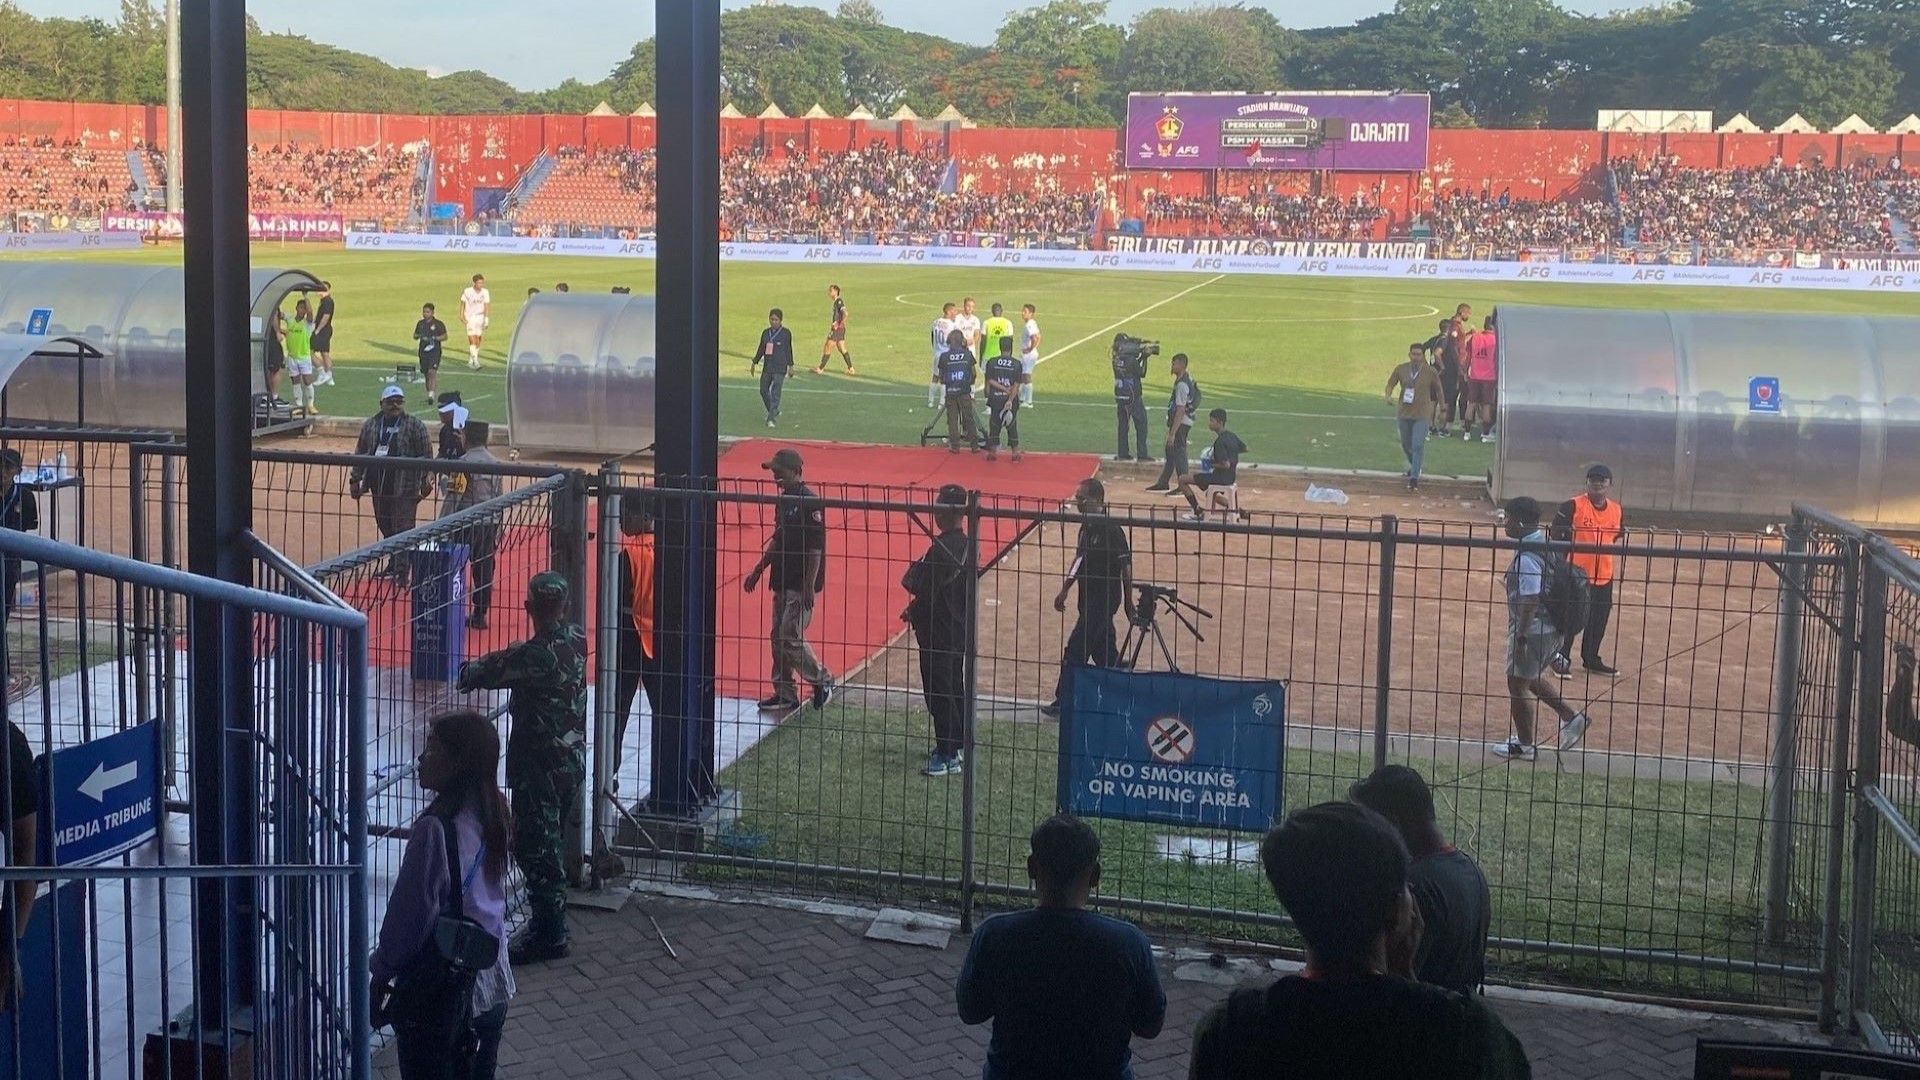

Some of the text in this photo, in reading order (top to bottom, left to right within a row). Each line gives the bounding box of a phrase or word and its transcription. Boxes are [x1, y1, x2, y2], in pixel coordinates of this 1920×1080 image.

[1237, 102, 1309, 116] STADION BRAWIJAYA
[1350, 122, 1410, 143] DJAJATI
[1176, 145, 1199, 155] AFG
[6, 234, 28, 247] AFG
[81, 234, 100, 245] AFG
[355, 236, 381, 246] AFG
[444, 239, 469, 249] AFG
[530, 240, 556, 251] AFG
[619, 243, 644, 254] AFG
[804, 248, 831, 258] AFG
[898, 249, 925, 260] AFG
[993, 252, 1022, 263] AFG
[1091, 255, 1120, 266] AFG
[1192, 257, 1222, 269] AFG
[1297, 260, 1329, 272] AFG
[1407, 263, 1438, 275] AFG
[1517, 266, 1551, 278] AFG
[1632, 269, 1665, 281] AFG
[1749, 271, 1783, 284] AFG
[1869, 275, 1904, 287] AFG
[949, 353, 965, 361] 027
[997, 358, 1012, 367] 022
[1104, 762, 1236, 788] NO SMOKING
[1088, 779, 1251, 809] OR VAPING AREA
[54, 796, 152, 847] MEDIA TRIBUNE
